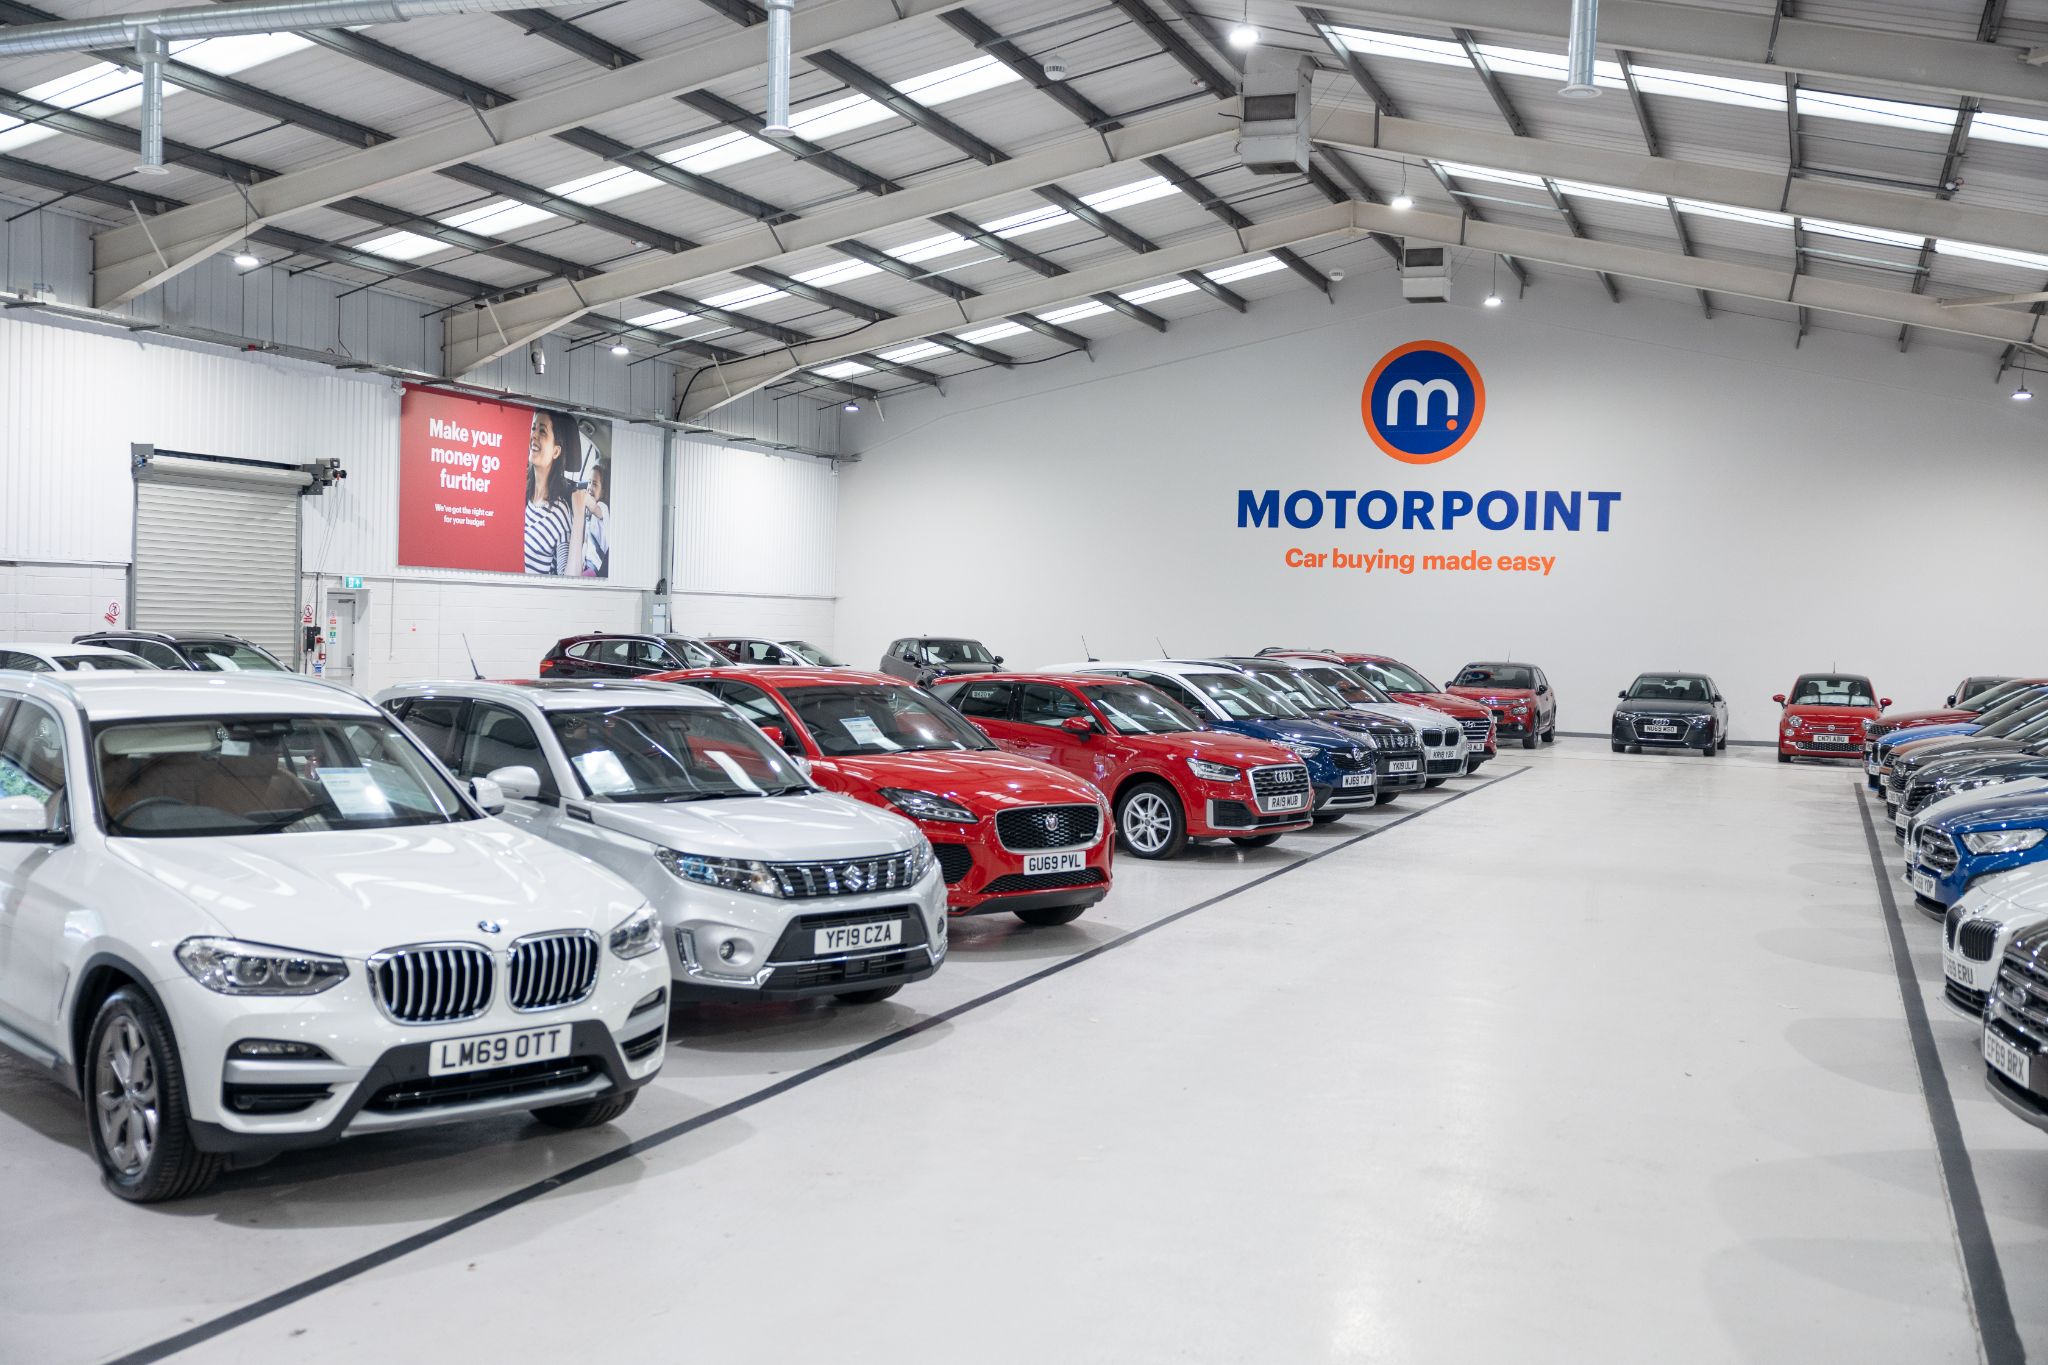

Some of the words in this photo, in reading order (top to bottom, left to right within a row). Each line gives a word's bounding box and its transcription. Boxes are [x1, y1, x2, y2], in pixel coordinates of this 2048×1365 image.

[429, 418, 469, 442] Make
[471, 429, 502, 448] your
[430, 447, 480, 471] money
[481, 454, 500, 474] go
[440, 468, 490, 492] further
[443, 515, 452, 523] for
[465, 517, 486, 528] budget
[452, 506, 462, 515] got
[462, 506, 472, 515] the
[472, 507, 485, 517] right
[1237, 489, 1622, 532] MOTORPOINT
[1285, 548, 1328, 568] Car
[1332, 548, 1415, 575] buying
[1422, 549, 1493, 571] made
[1497, 554, 1556, 576] easy
[1028, 856, 1058, 871] GU69
[1061, 854, 1081, 869] PVL
[826, 928, 860, 948] YF19
[864, 924, 892, 944] CZA
[1957, 962, 1974, 985] ERU
[440, 1038, 508, 1069] LM69
[516, 1029, 561, 1058] OTT
[1986, 1035, 2006, 1067] EF69
[2007, 1049, 2025, 1082] BRX
